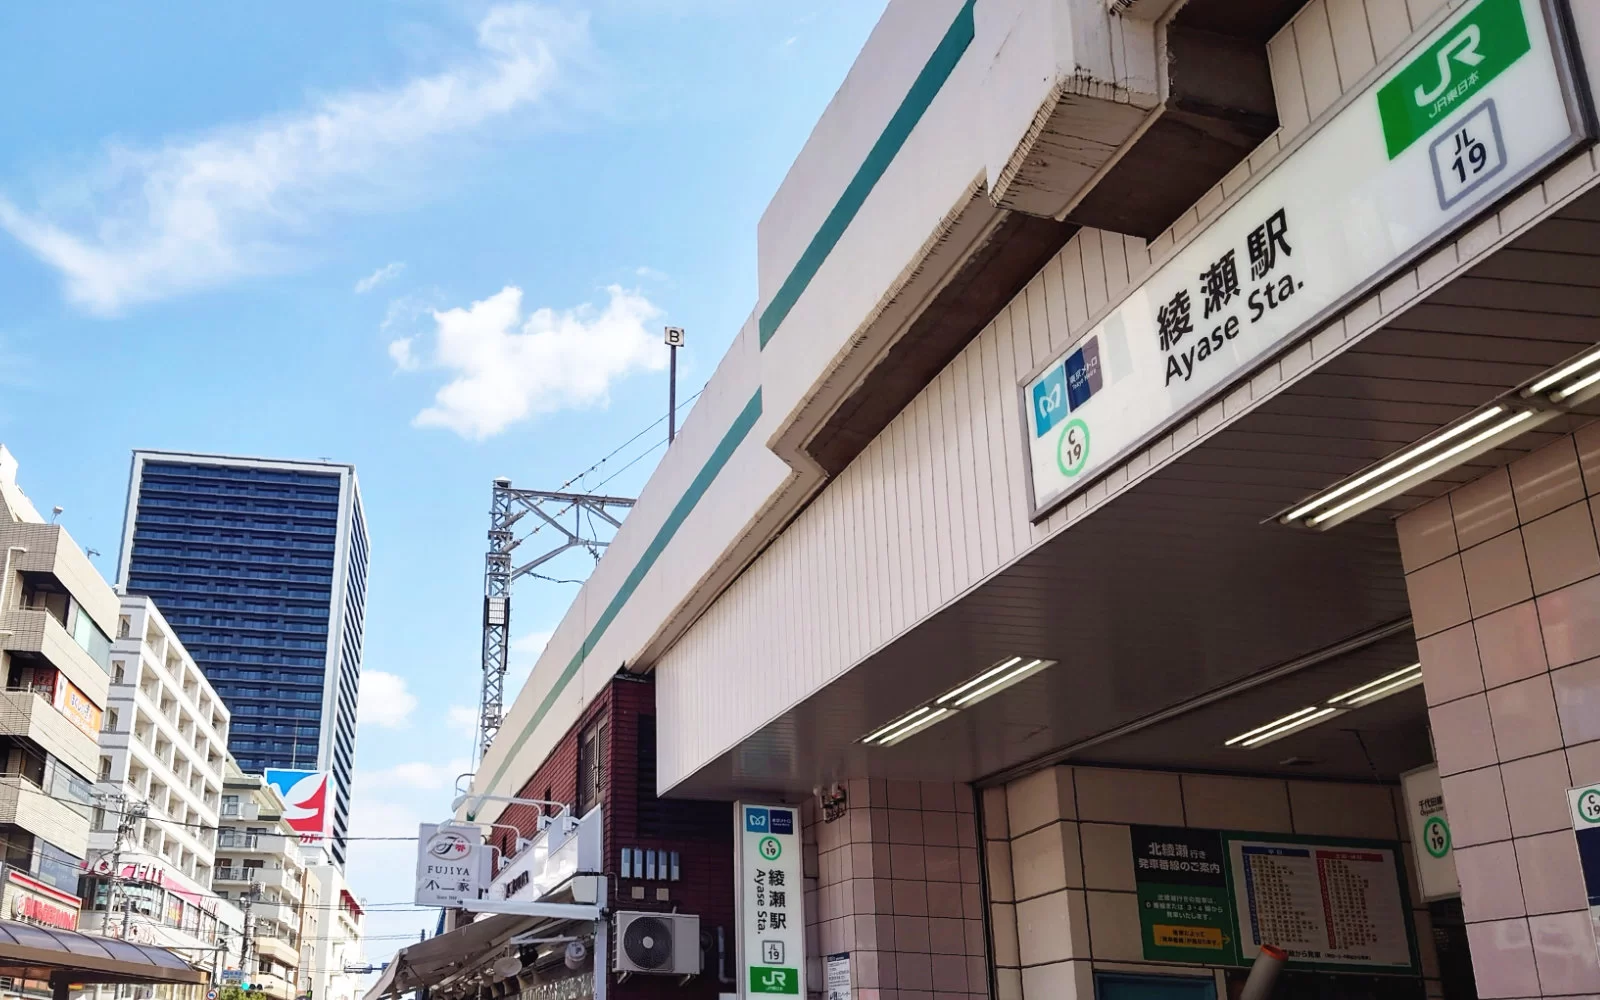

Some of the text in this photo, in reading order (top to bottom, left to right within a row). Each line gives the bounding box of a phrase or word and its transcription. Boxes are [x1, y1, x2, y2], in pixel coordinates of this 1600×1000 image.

[1414, 23, 1486, 107] JR
[1429, 70, 1479, 118] JR東日本
[1455, 128, 1475, 155] JL
[1452, 142, 1486, 183] 19
[1157, 206, 1292, 352] 綾瀬駅
[669, 329, 680, 343] B
[1165, 274, 1304, 387] Ayase Sta.
[1070, 355, 1098, 385] 東京メトロ
[1068, 429, 1076, 445] C
[1066, 443, 1082, 466] 19
[1588, 794, 1595, 805] C
[1432, 823, 1439, 835] C
[767, 840, 773, 848] C
[1432, 836, 1444, 850] 19
[427, 865, 470, 876] FUJIYA
[1138, 858, 1220, 874] 発車番線のご案内
[754, 868, 767, 935] Ayase Sta.
[768, 868, 786, 930] 綾瀬駅
[768, 950, 779, 960] 19
[769, 943, 778, 951] JL
[762, 971, 786, 987] JR
